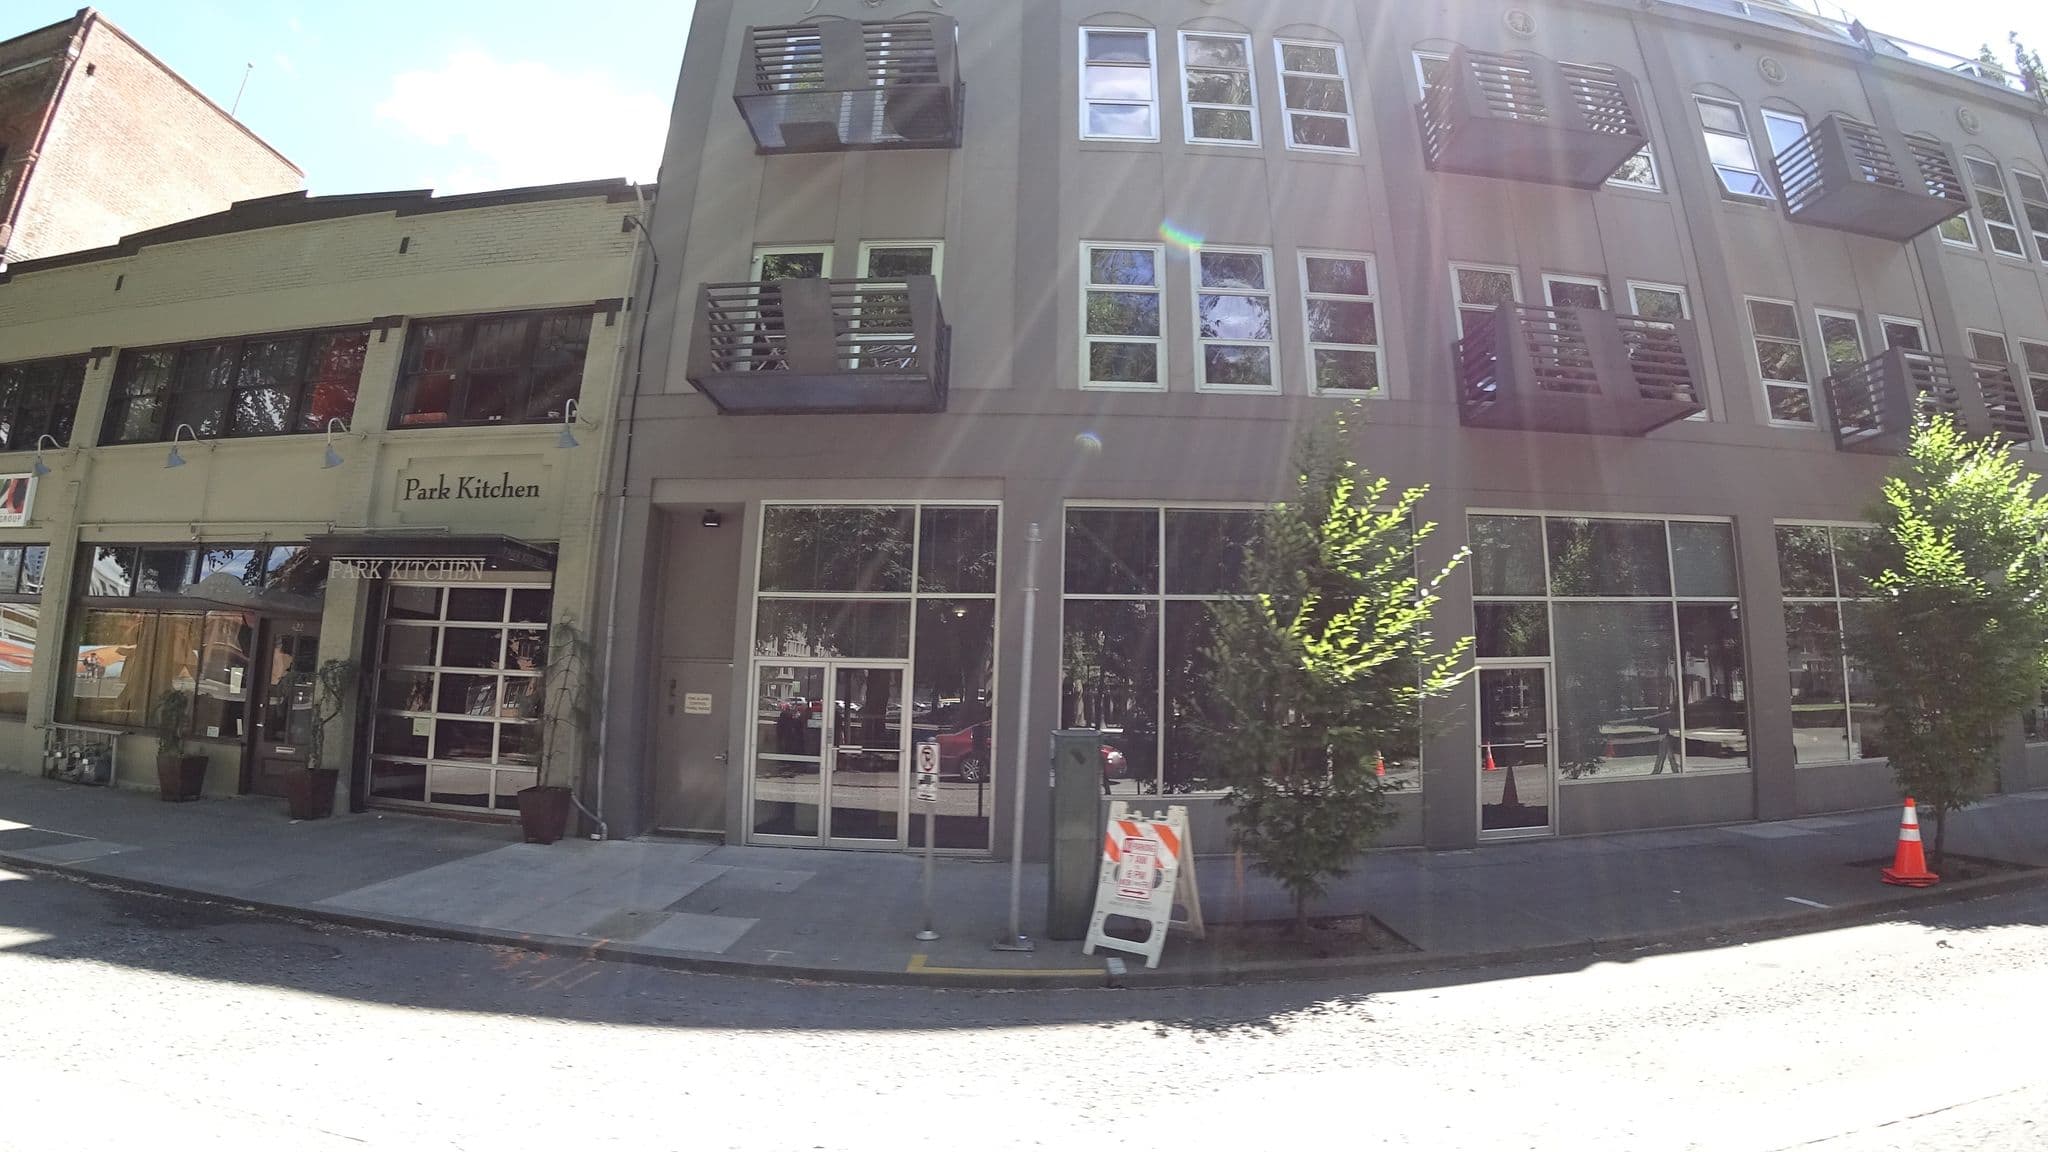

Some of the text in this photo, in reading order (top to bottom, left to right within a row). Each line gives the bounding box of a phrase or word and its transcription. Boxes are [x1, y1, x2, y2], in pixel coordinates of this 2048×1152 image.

[403, 471, 540, 501] Park Kitchen
[329, 559, 486, 581] PARK KITCHEN
